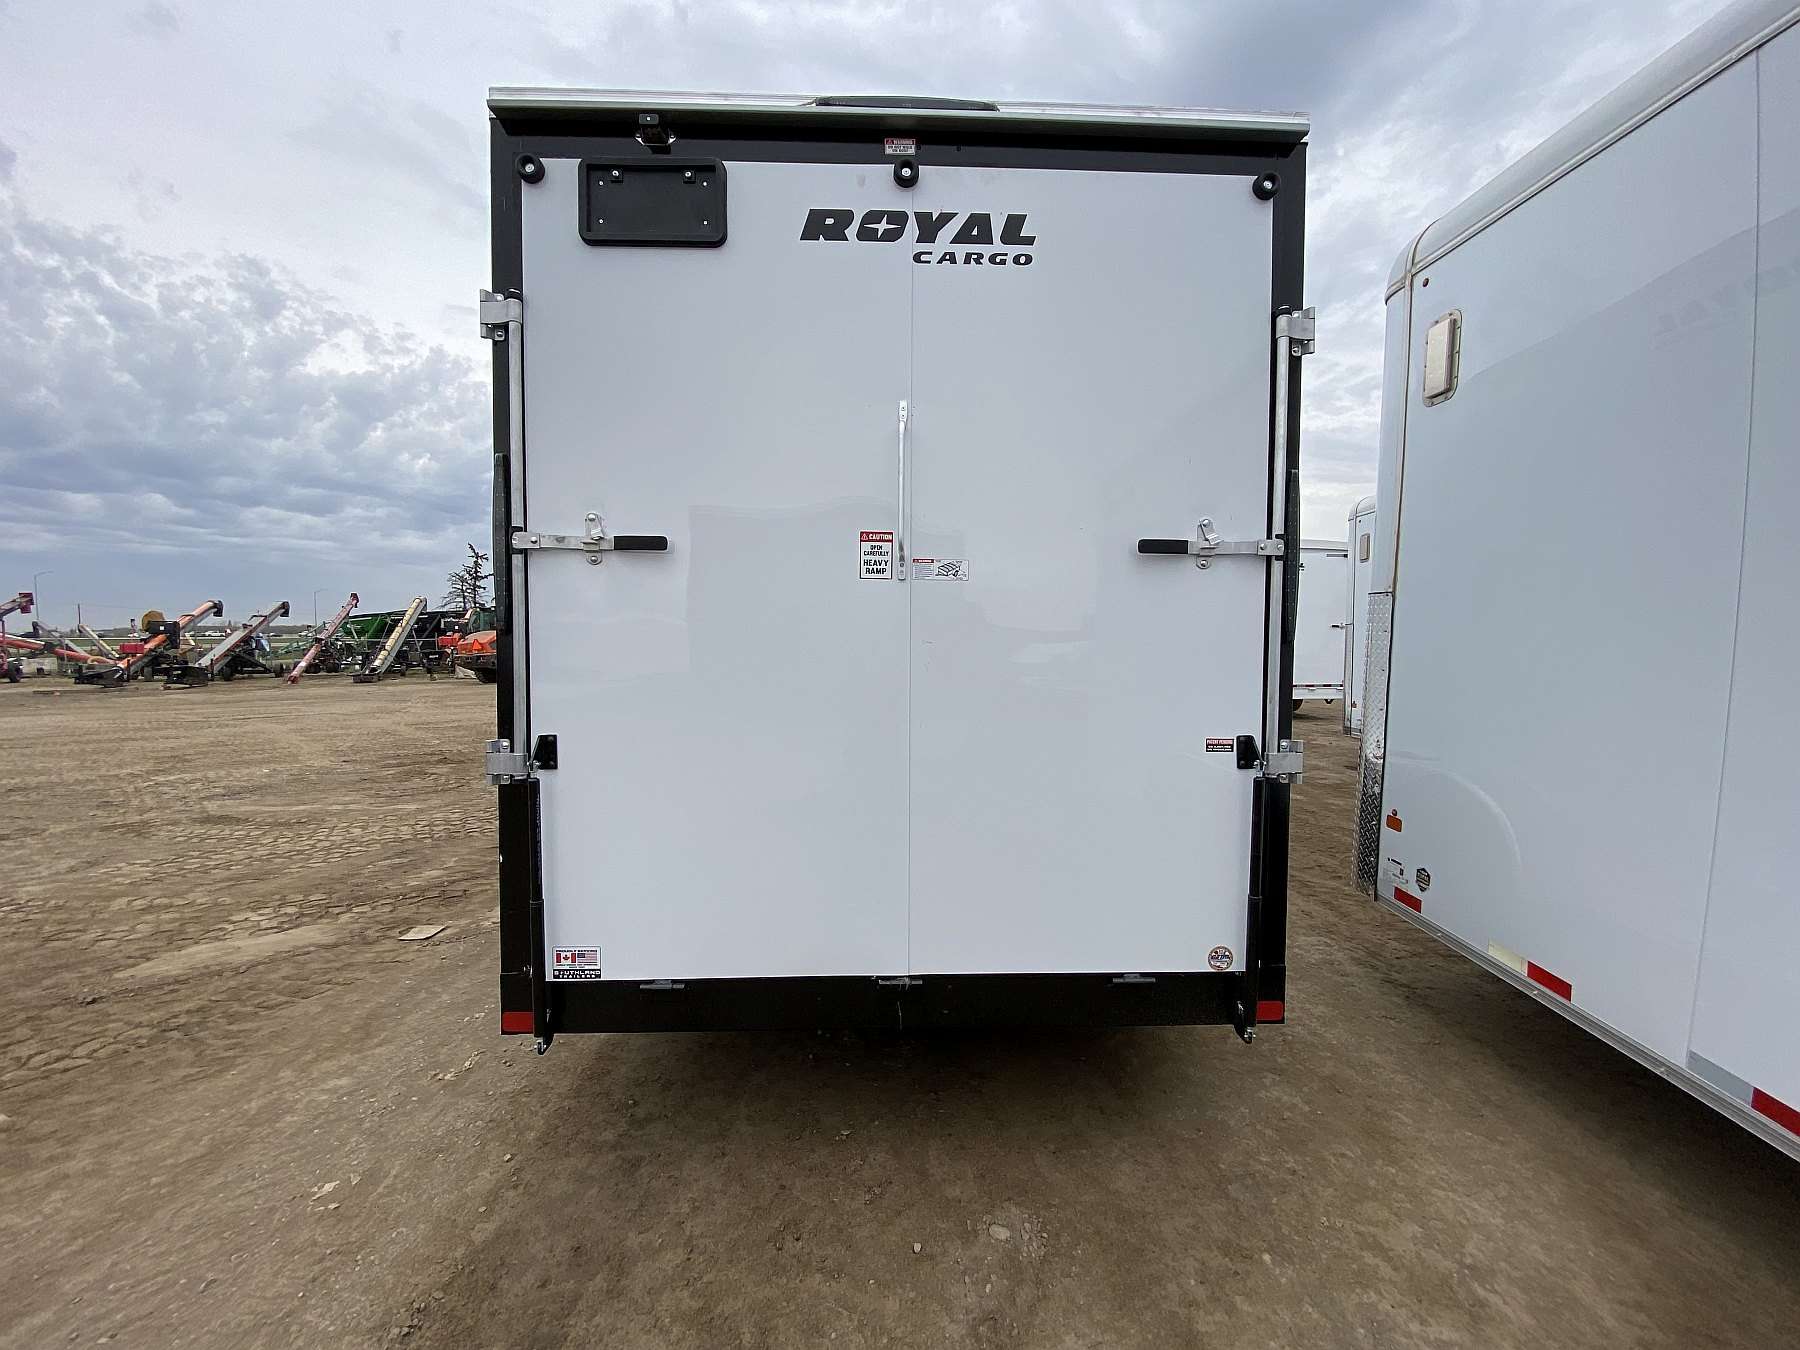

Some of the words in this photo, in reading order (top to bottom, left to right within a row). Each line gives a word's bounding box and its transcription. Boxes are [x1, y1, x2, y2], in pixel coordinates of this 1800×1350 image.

[800, 208, 1036, 245] ROYAL
[912, 251, 1033, 266] CARGO
[863, 559, 889, 567] HEAVY
